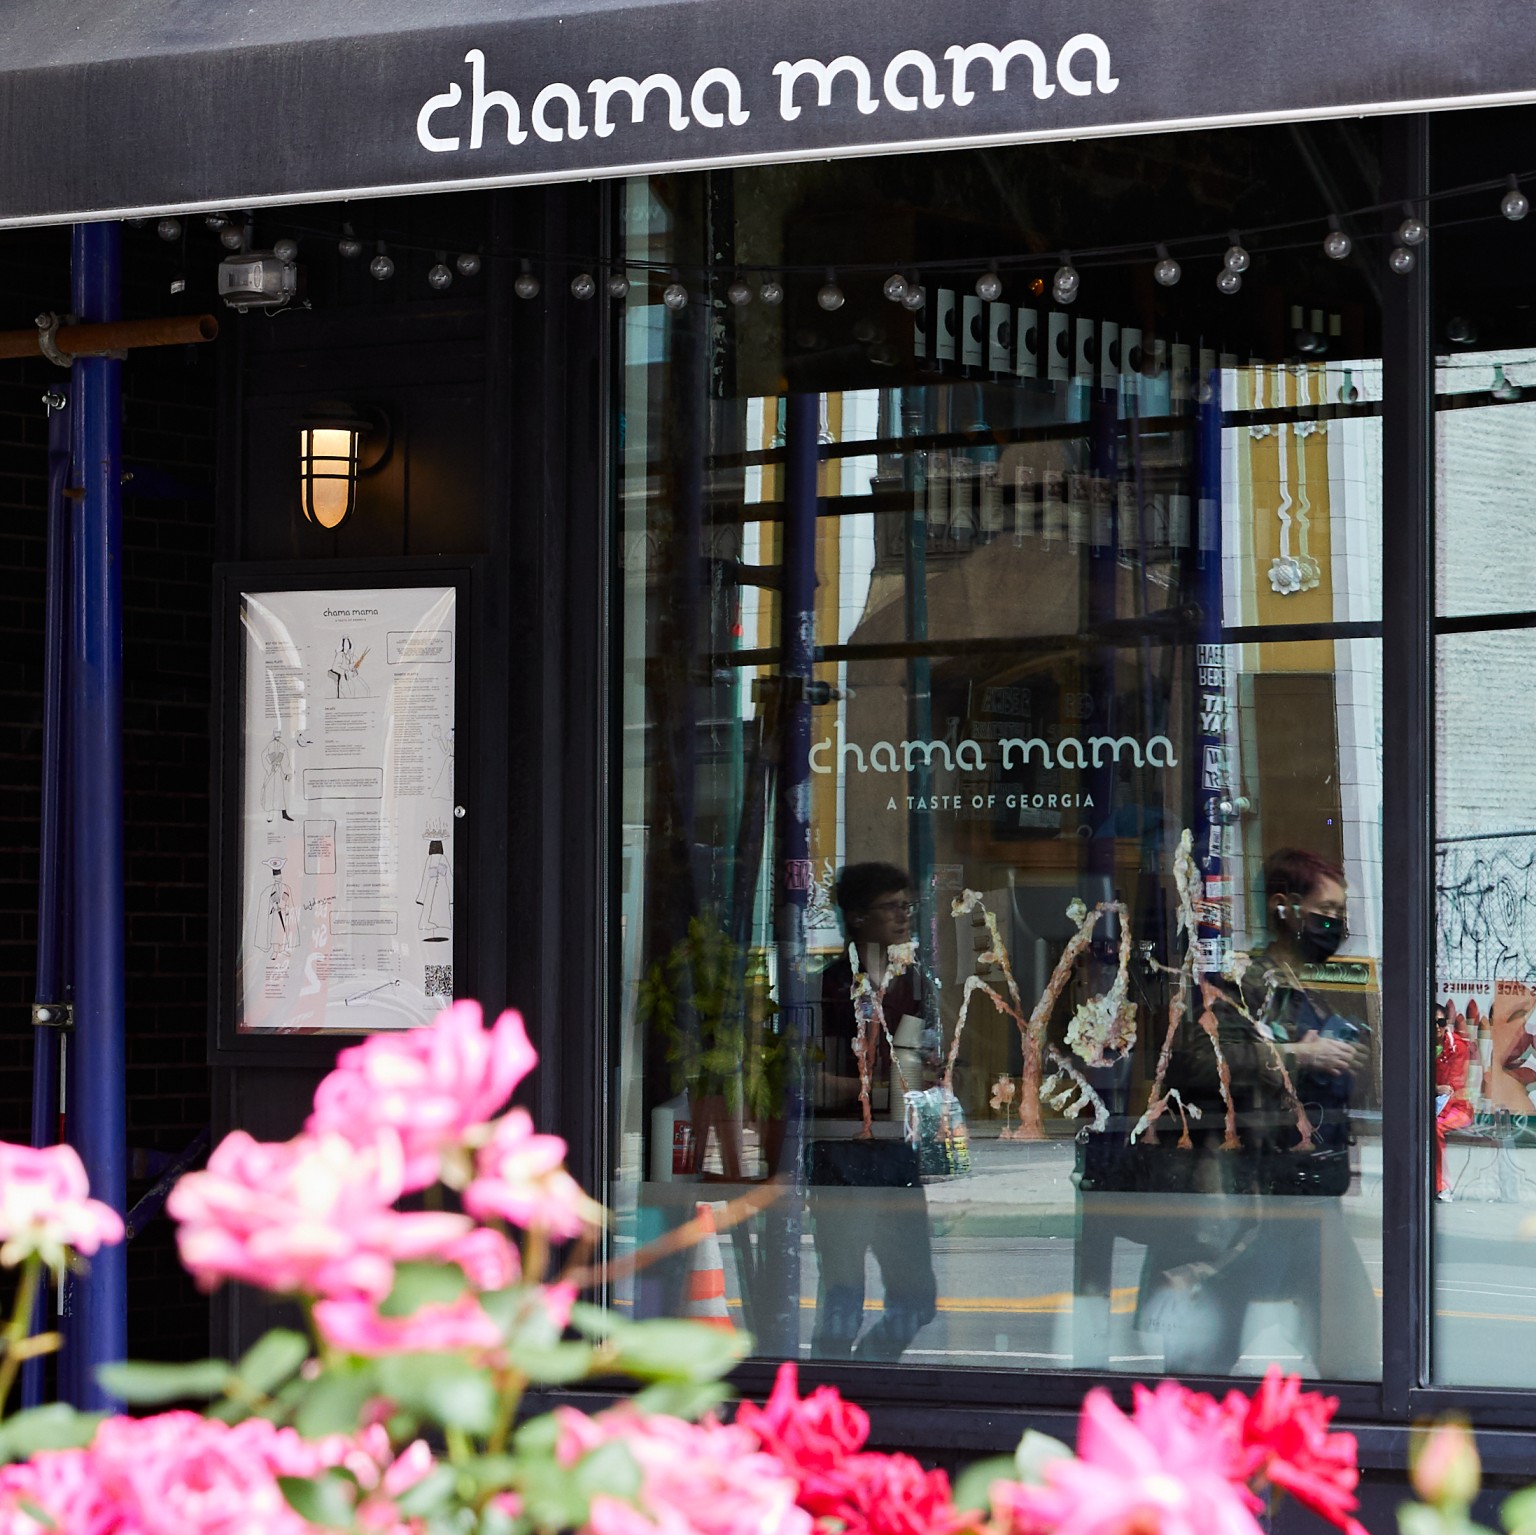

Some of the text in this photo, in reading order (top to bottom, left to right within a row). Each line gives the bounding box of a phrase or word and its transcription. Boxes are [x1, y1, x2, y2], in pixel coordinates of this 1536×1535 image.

[416, 33, 1120, 153] chama mama
[323, 608, 379, 617] chama mama
[808, 720, 987, 774] chama
[998, 734, 1178, 770] mama
[886, 792, 1095, 811] A TASTE OF GEORGIA
